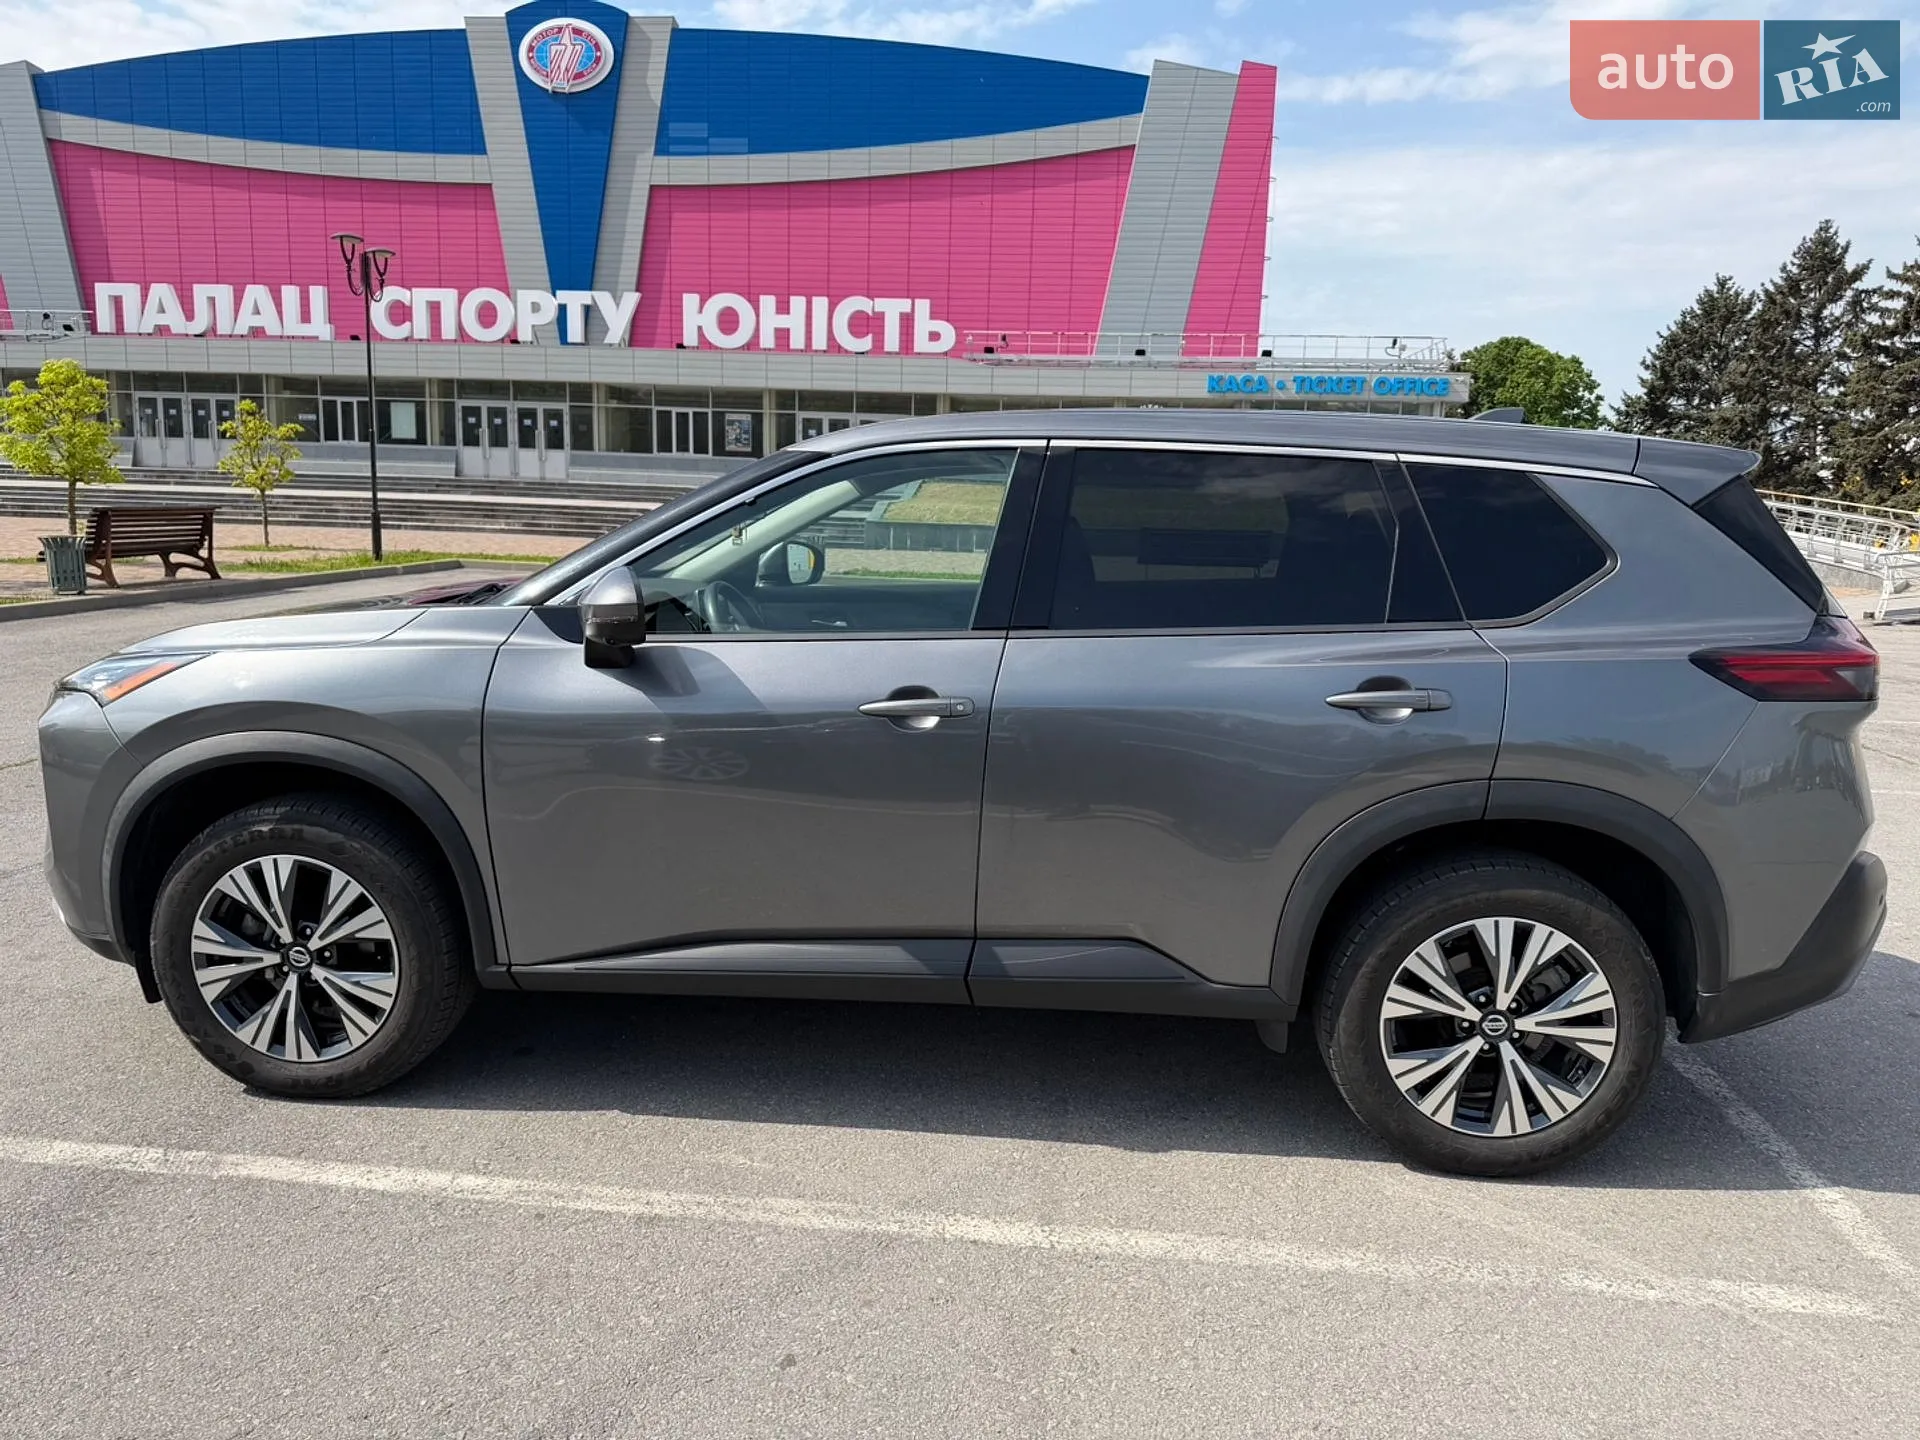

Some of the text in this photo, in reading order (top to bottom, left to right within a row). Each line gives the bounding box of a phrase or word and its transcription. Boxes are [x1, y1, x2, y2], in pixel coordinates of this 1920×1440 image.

[94, 282, 956, 353] ПАЛАЦ СПОРТУ ЮНІСТЬ
[1207, 374, 1450, 397] КАСА TICKET OFFICE
